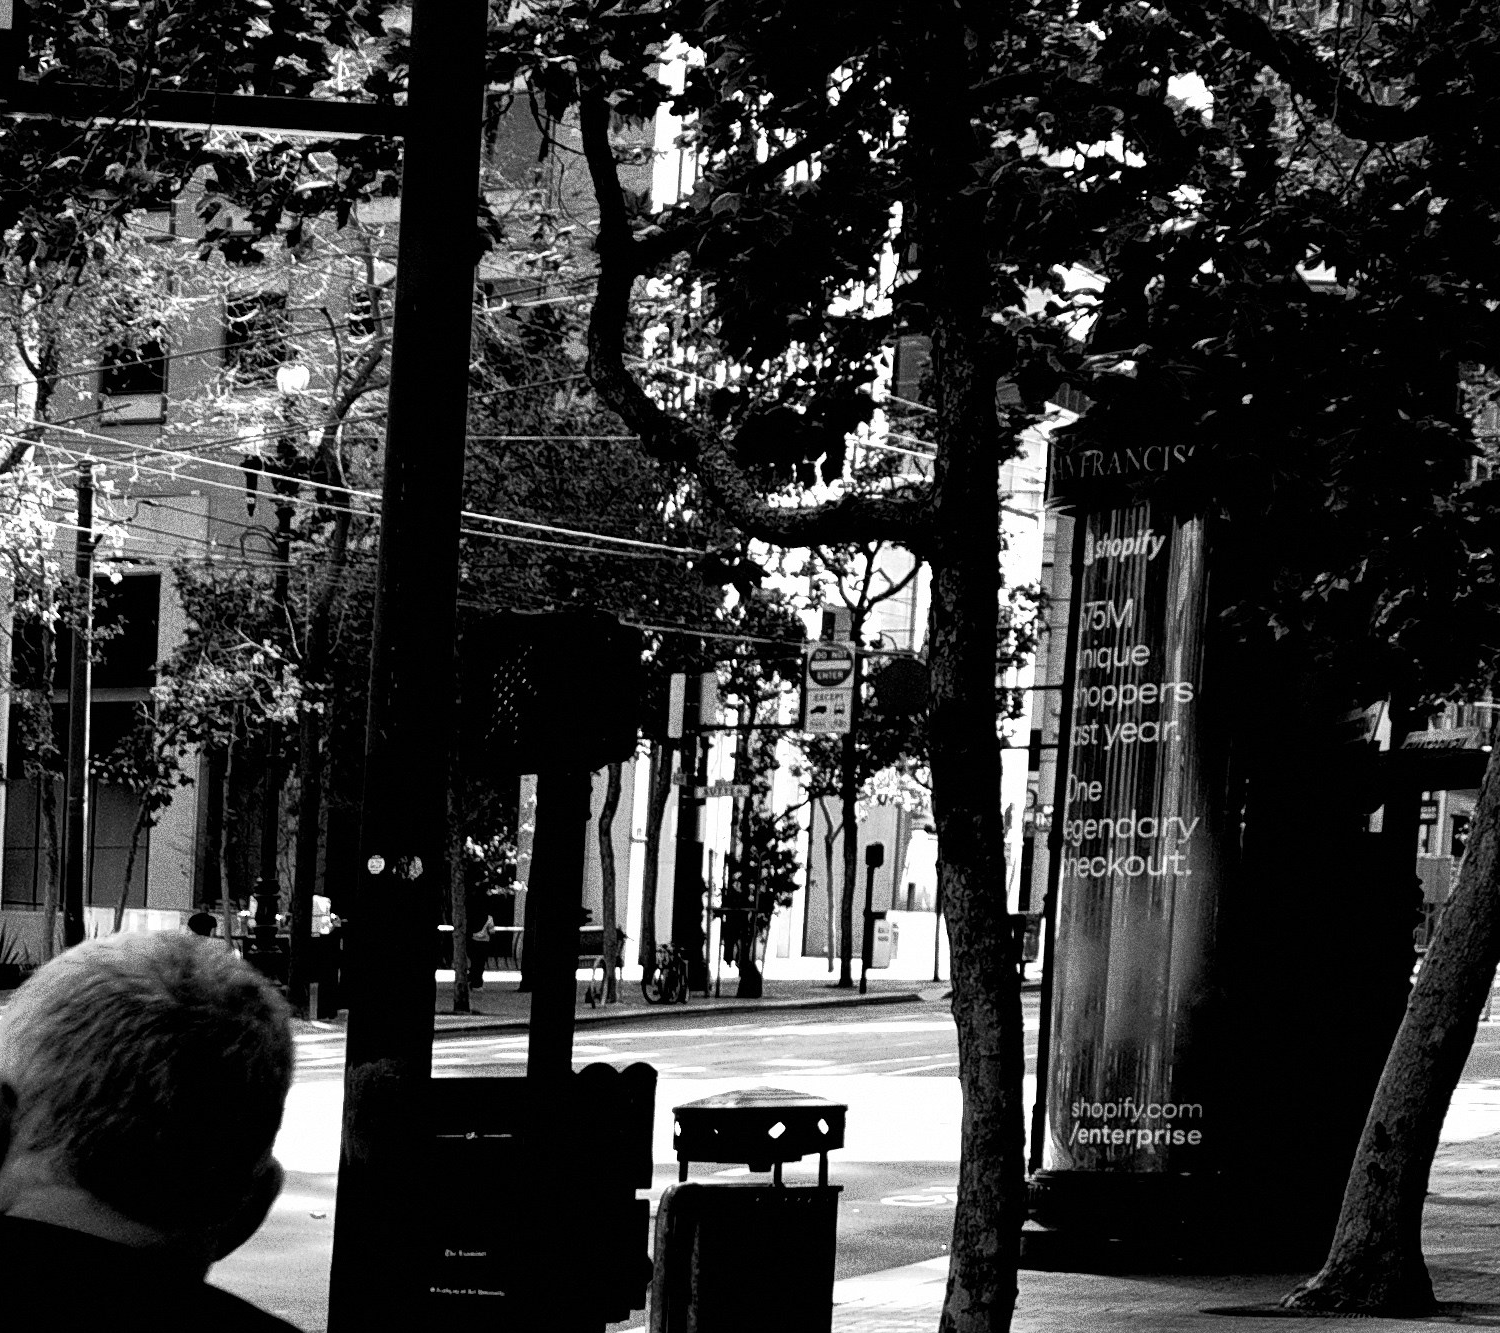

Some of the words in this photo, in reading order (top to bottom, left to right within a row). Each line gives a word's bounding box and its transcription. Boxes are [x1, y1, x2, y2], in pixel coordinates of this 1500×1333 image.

[1095, 528, 1167, 562] shopify
[815, 651, 828, 660] DO
[831, 650, 848, 659] NOT
[1079, 639, 1151, 675] nique
[816, 671, 844, 680] ENTER
[1076, 680, 1194, 713] hoppers
[1072, 718, 1100, 747] ast
[1103, 720, 1180, 751] year.
[1064, 808, 1200, 847] egendary
[1063, 847, 1192, 878] heckout.
[1071, 1096, 1203, 1124] shopify.com
[1068, 1120, 1203, 1150] /enterprise
